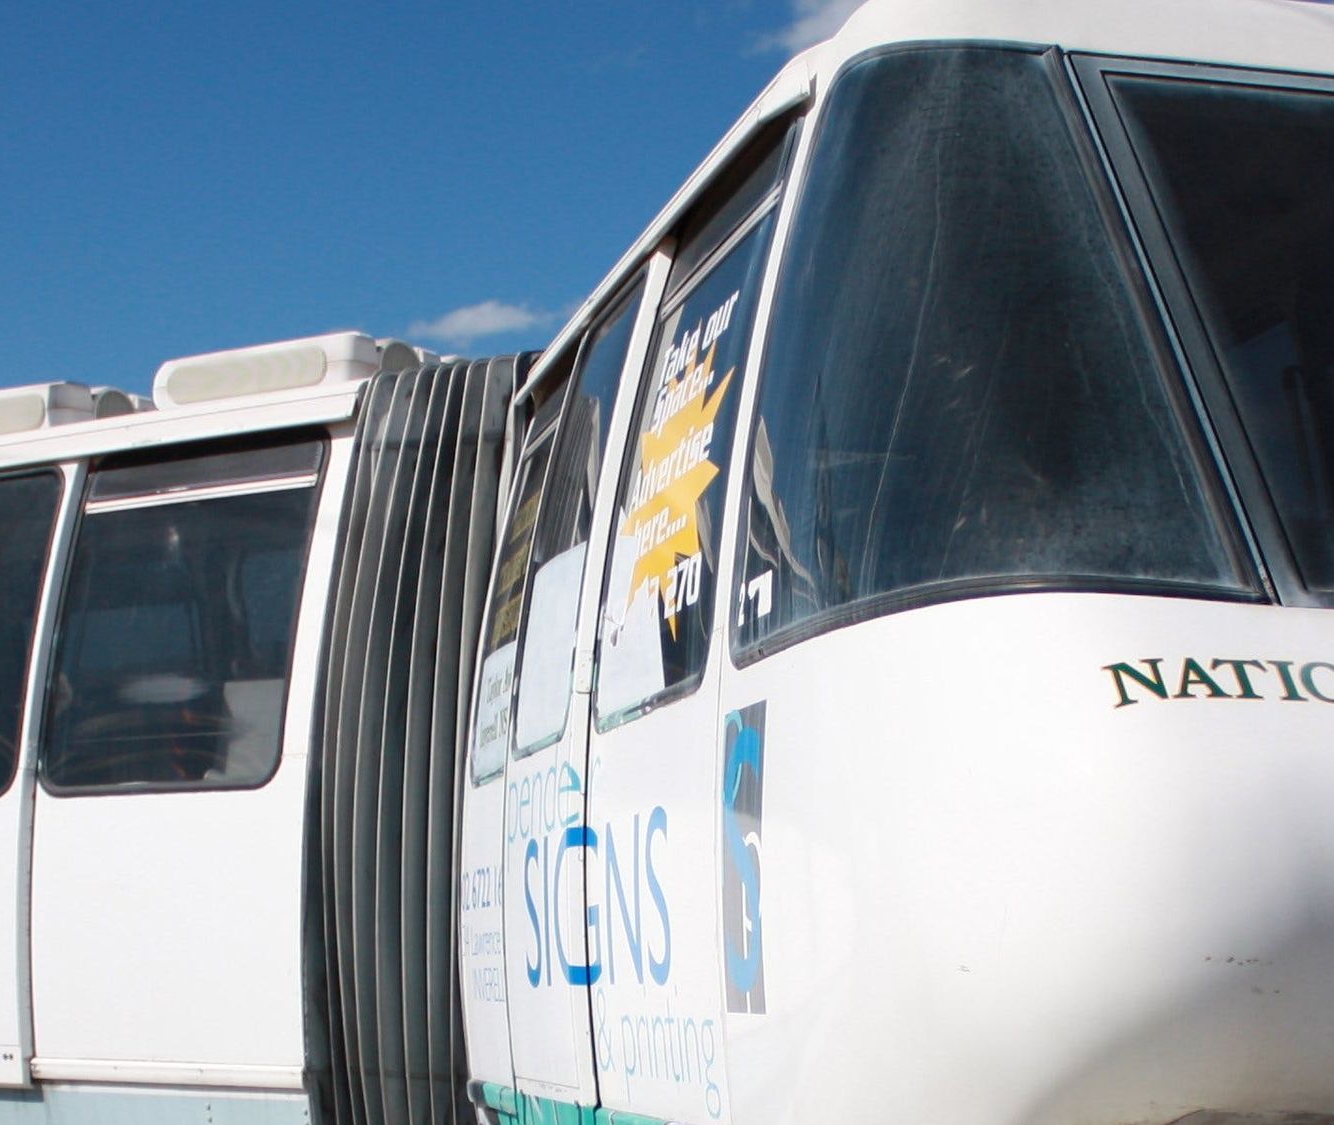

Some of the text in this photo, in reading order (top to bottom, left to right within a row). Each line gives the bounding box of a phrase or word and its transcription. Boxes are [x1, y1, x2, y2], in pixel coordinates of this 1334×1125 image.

[659, 290, 739, 391] Take our
[629, 423, 713, 518] Advertise
[508, 743, 602, 872] pender
[524, 805, 670, 987] SIGNS
[596, 986, 722, 1119] & printing
